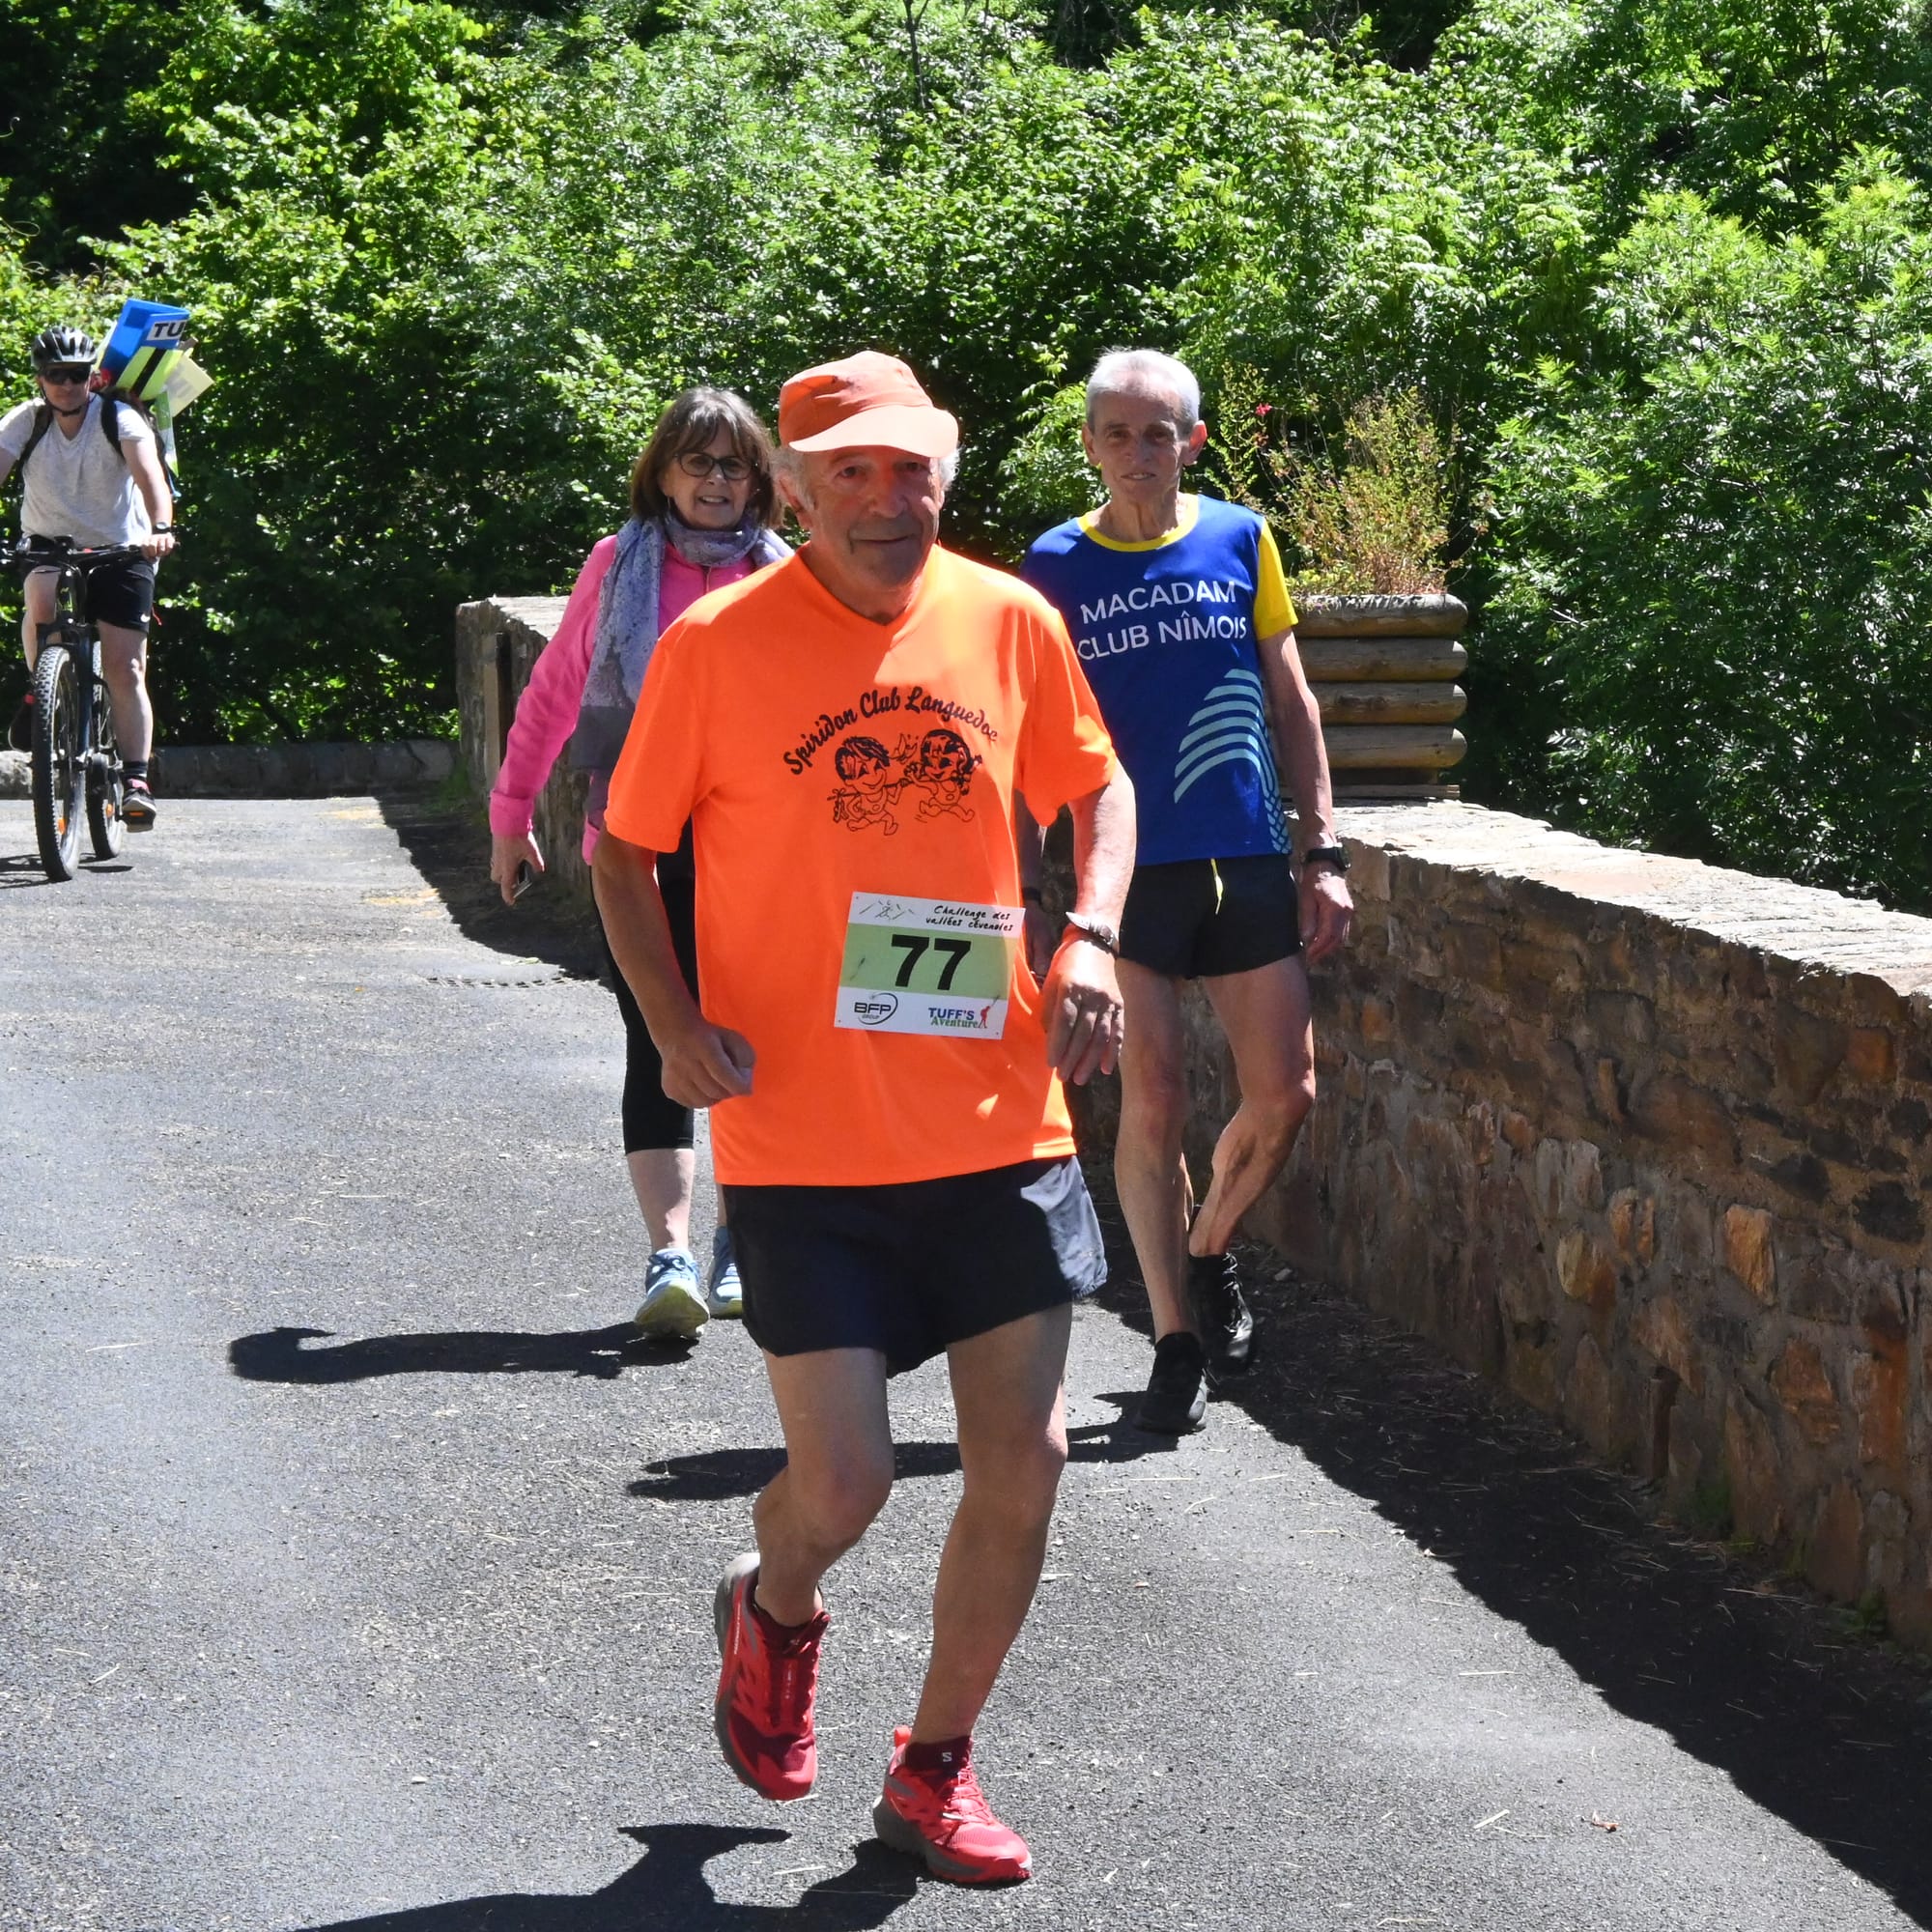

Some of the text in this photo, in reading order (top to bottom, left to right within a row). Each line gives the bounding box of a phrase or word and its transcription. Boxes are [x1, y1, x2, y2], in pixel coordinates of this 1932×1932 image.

[1080, 581, 1236, 624] MACADAM
[1077, 611, 1246, 660] CLUB NÎMOIS
[783, 686, 998, 775] Spiridon Club Languedoc
[933, 905, 1010, 921] Challenge des
[925, 916, 1013, 932] vallées cévenoles
[891, 934, 972, 991] 77
[854, 1002, 892, 1014] BFP
[927, 1007, 975, 1021] TUFF'S
[930, 1015, 980, 1029] Aventure
